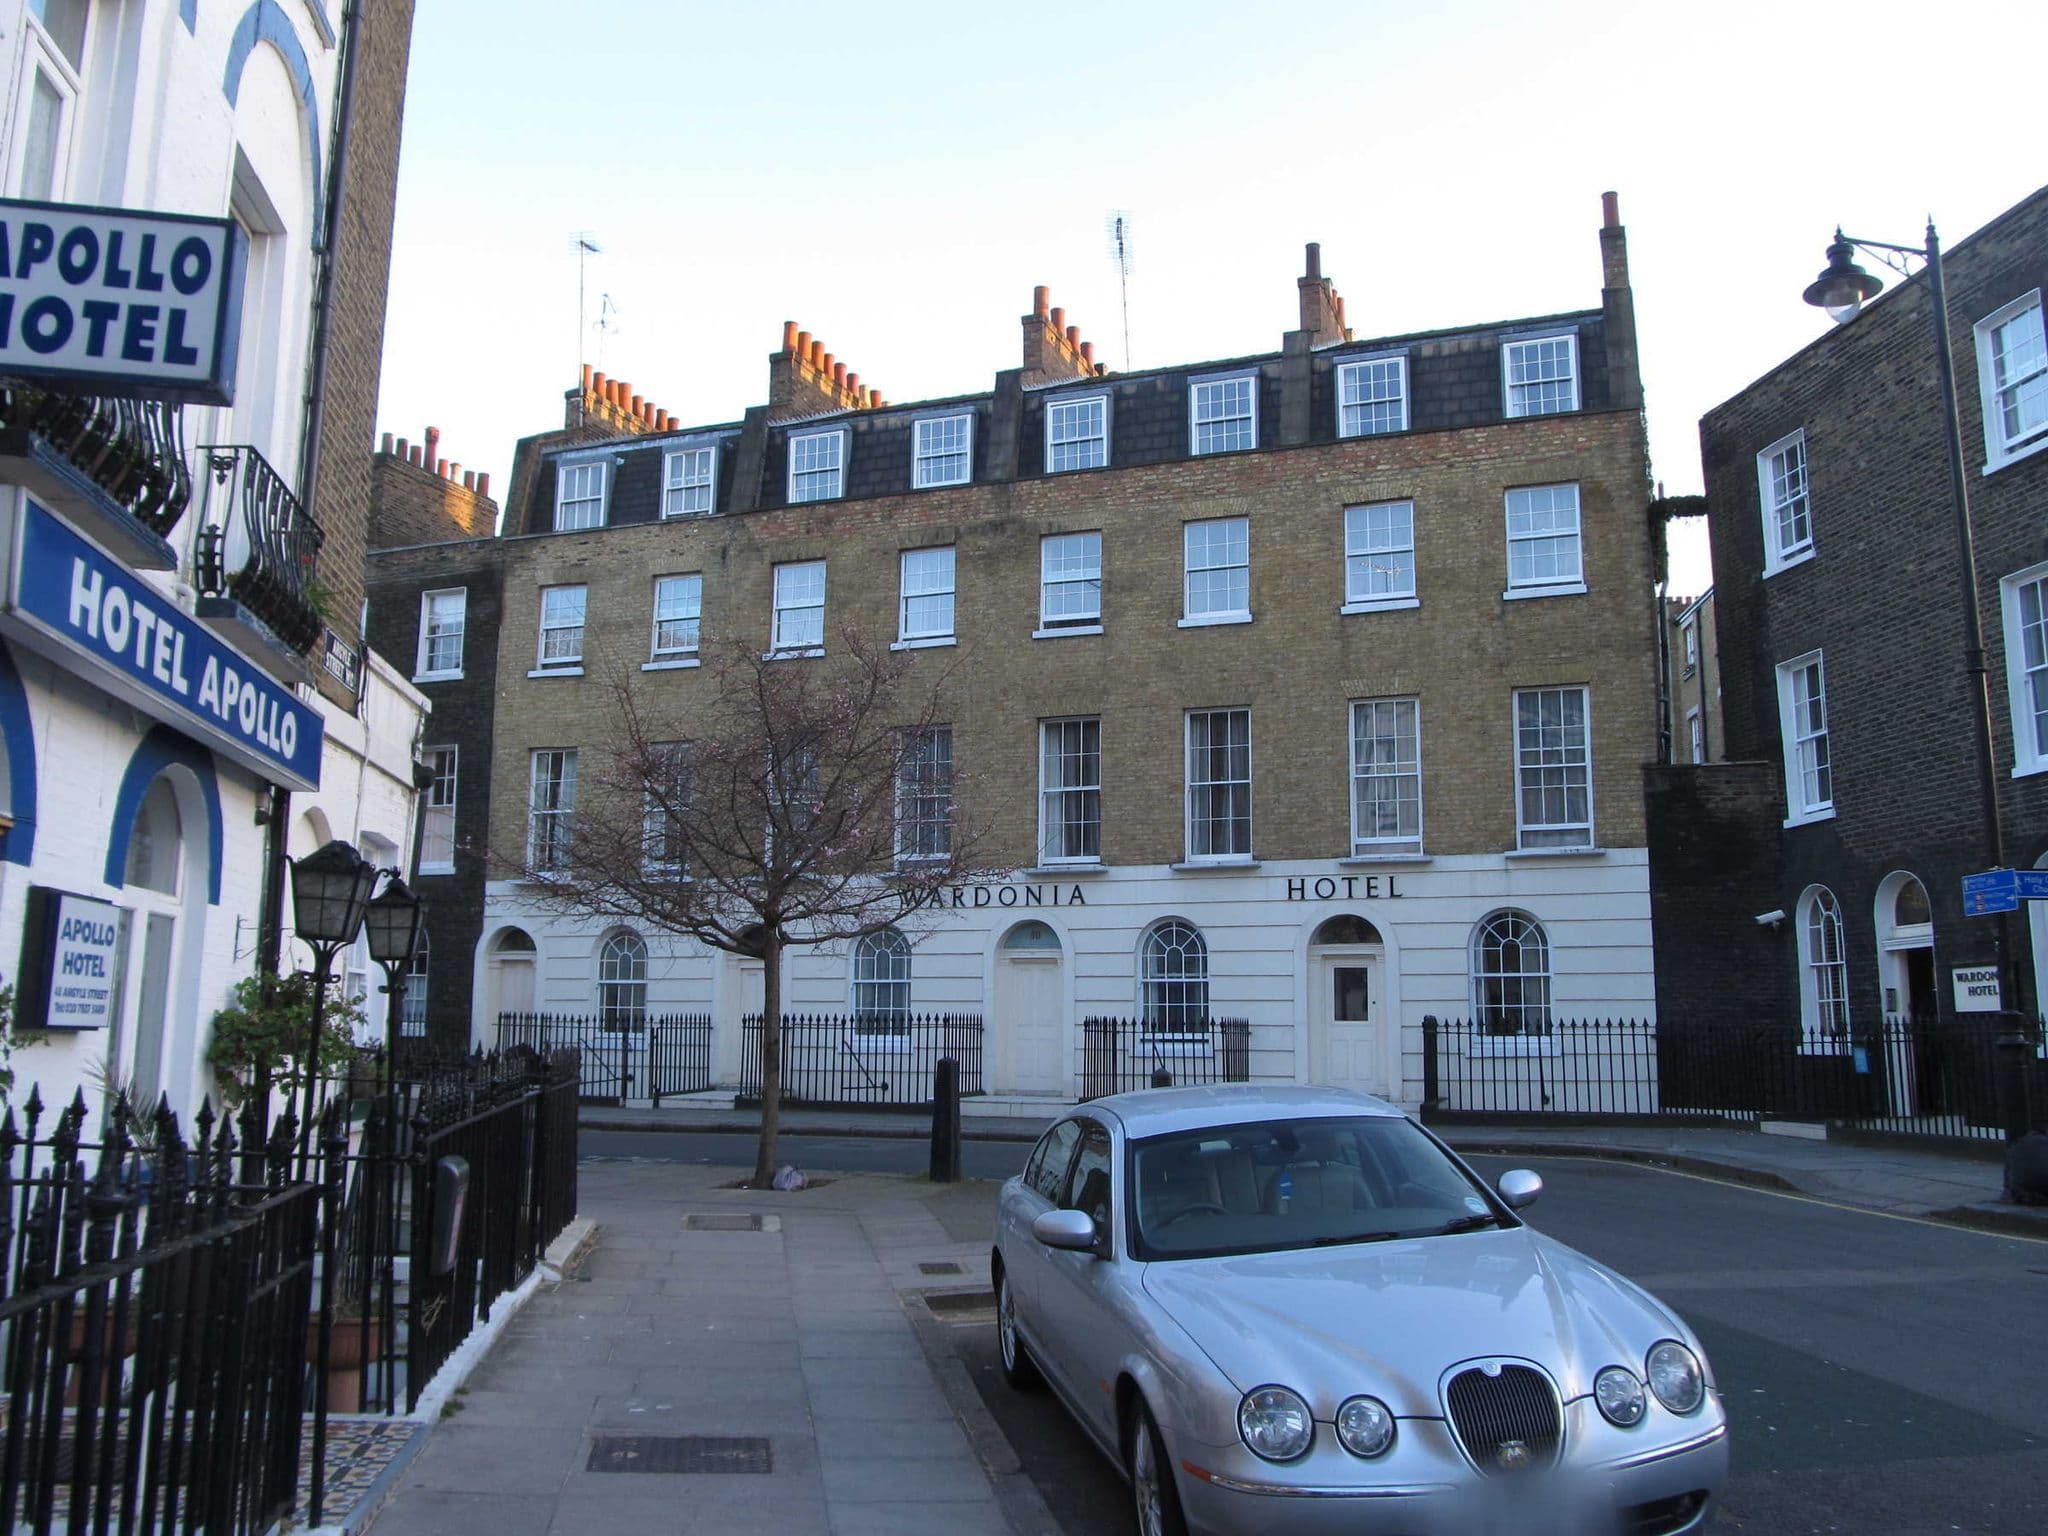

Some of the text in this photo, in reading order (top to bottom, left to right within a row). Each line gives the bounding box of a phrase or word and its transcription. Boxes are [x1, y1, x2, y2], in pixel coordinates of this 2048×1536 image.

[69, 557, 297, 760] HOTEL APOLLO
[326, 651, 345, 680] STREET
[900, 875, 1403, 908] WARDONIA HOTEL
[61, 917, 115, 946] APOLLO
[62, 951, 105, 978] HOTEL
[87, 988, 108, 1000] STREET
[1968, 985, 1998, 997] HOTEL
